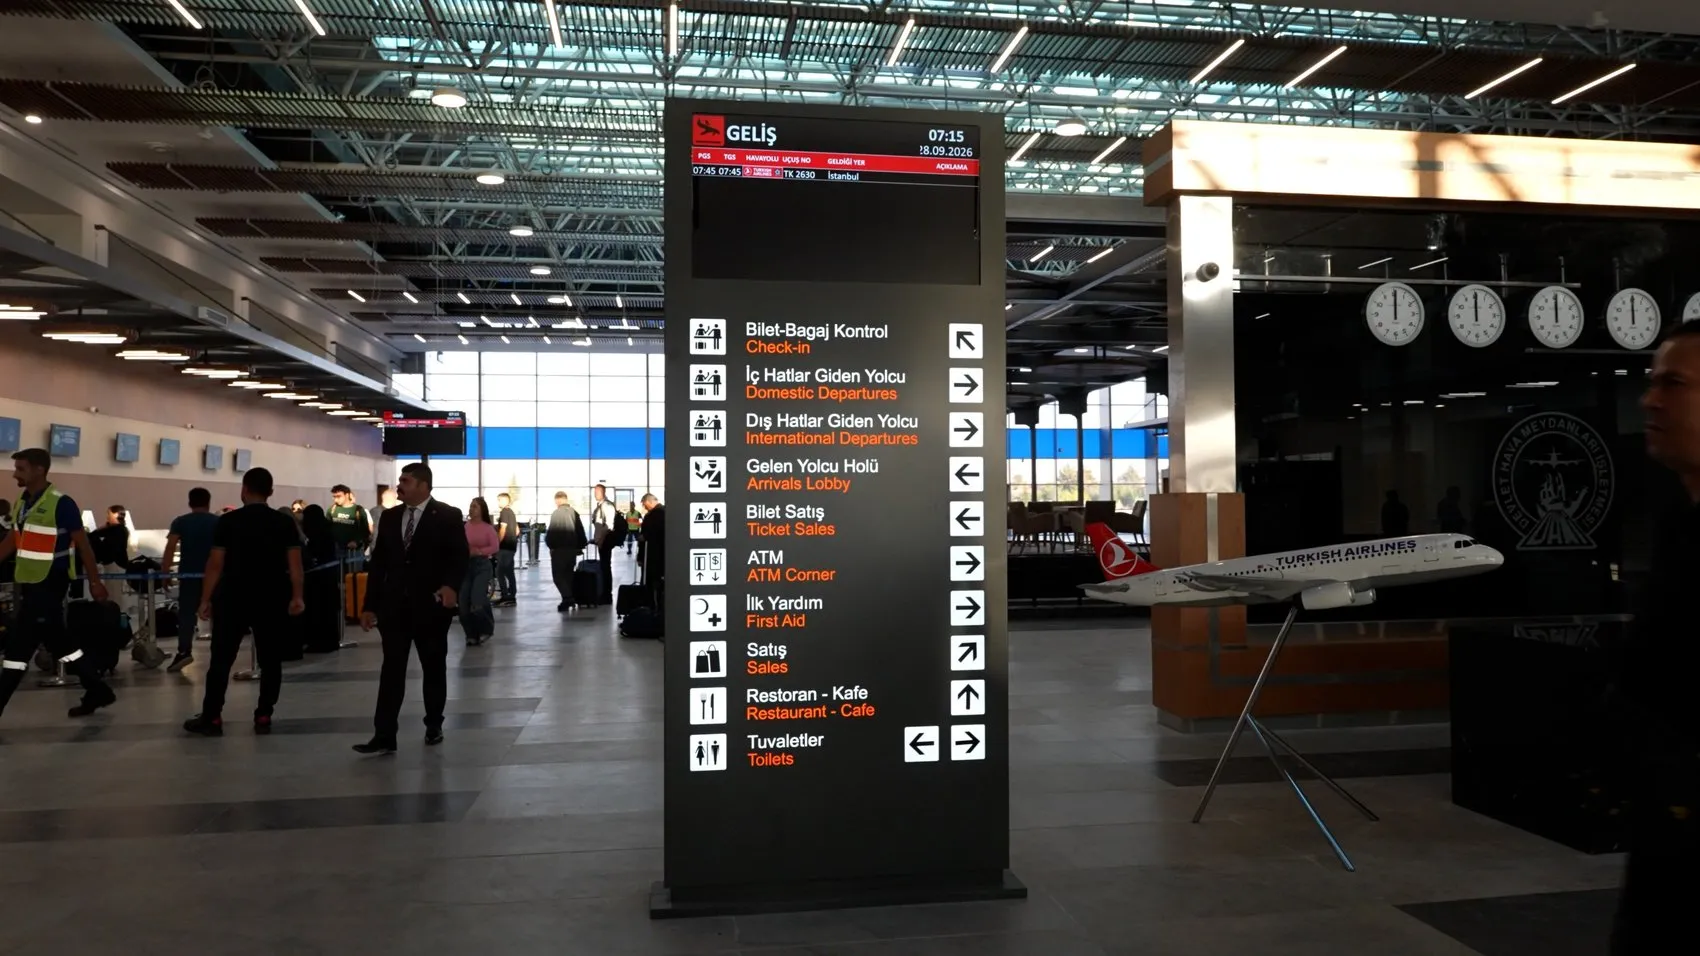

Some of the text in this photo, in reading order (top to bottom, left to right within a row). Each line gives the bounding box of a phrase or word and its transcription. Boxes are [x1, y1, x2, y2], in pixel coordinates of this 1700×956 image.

[727, 123, 777, 146] GELİŞ
[929, 129, 964, 142] 07:15
[698, 152, 711, 160] PGS
[782, 156, 799, 164] UÇUŞ
[693, 166, 860, 180] 07:45 07:45 TK 2630 İstanbul
[746, 322, 888, 341] Bilet-Bagaj Kontrol
[746, 340, 810, 354] Check-in
[746, 364, 906, 385] İç Hatlar Giden Yolcu
[746, 385, 897, 402] Domestic Departures
[746, 413, 918, 431] Dış Hatlar Giden Yolcu
[746, 431, 918, 447] International Departures
[1500, 435, 1524, 473] HAVA
[746, 459, 879, 473] Gelen Yolcu Holü
[747, 477, 850, 493] Arrivals Lobby
[1499, 476, 1530, 530] DEVLET
[746, 504, 825, 522] Bilet Satış
[747, 521, 835, 536] Ticket Sales
[747, 550, 783, 565] ATM
[1276, 540, 1417, 566] TURKISH AIRLINES
[747, 568, 835, 582] ATM Corner
[746, 594, 823, 611] İlk Yardım
[747, 614, 805, 628] First Aid
[747, 643, 787, 659] Satış
[747, 661, 788, 675] Sales
[747, 687, 817, 703] Restoran
[832, 686, 868, 701] Kafe
[746, 705, 827, 721] Restaurant
[841, 703, 875, 718] Cafe
[747, 733, 825, 749] Tuvaletler
[748, 752, 794, 767] Toilets
